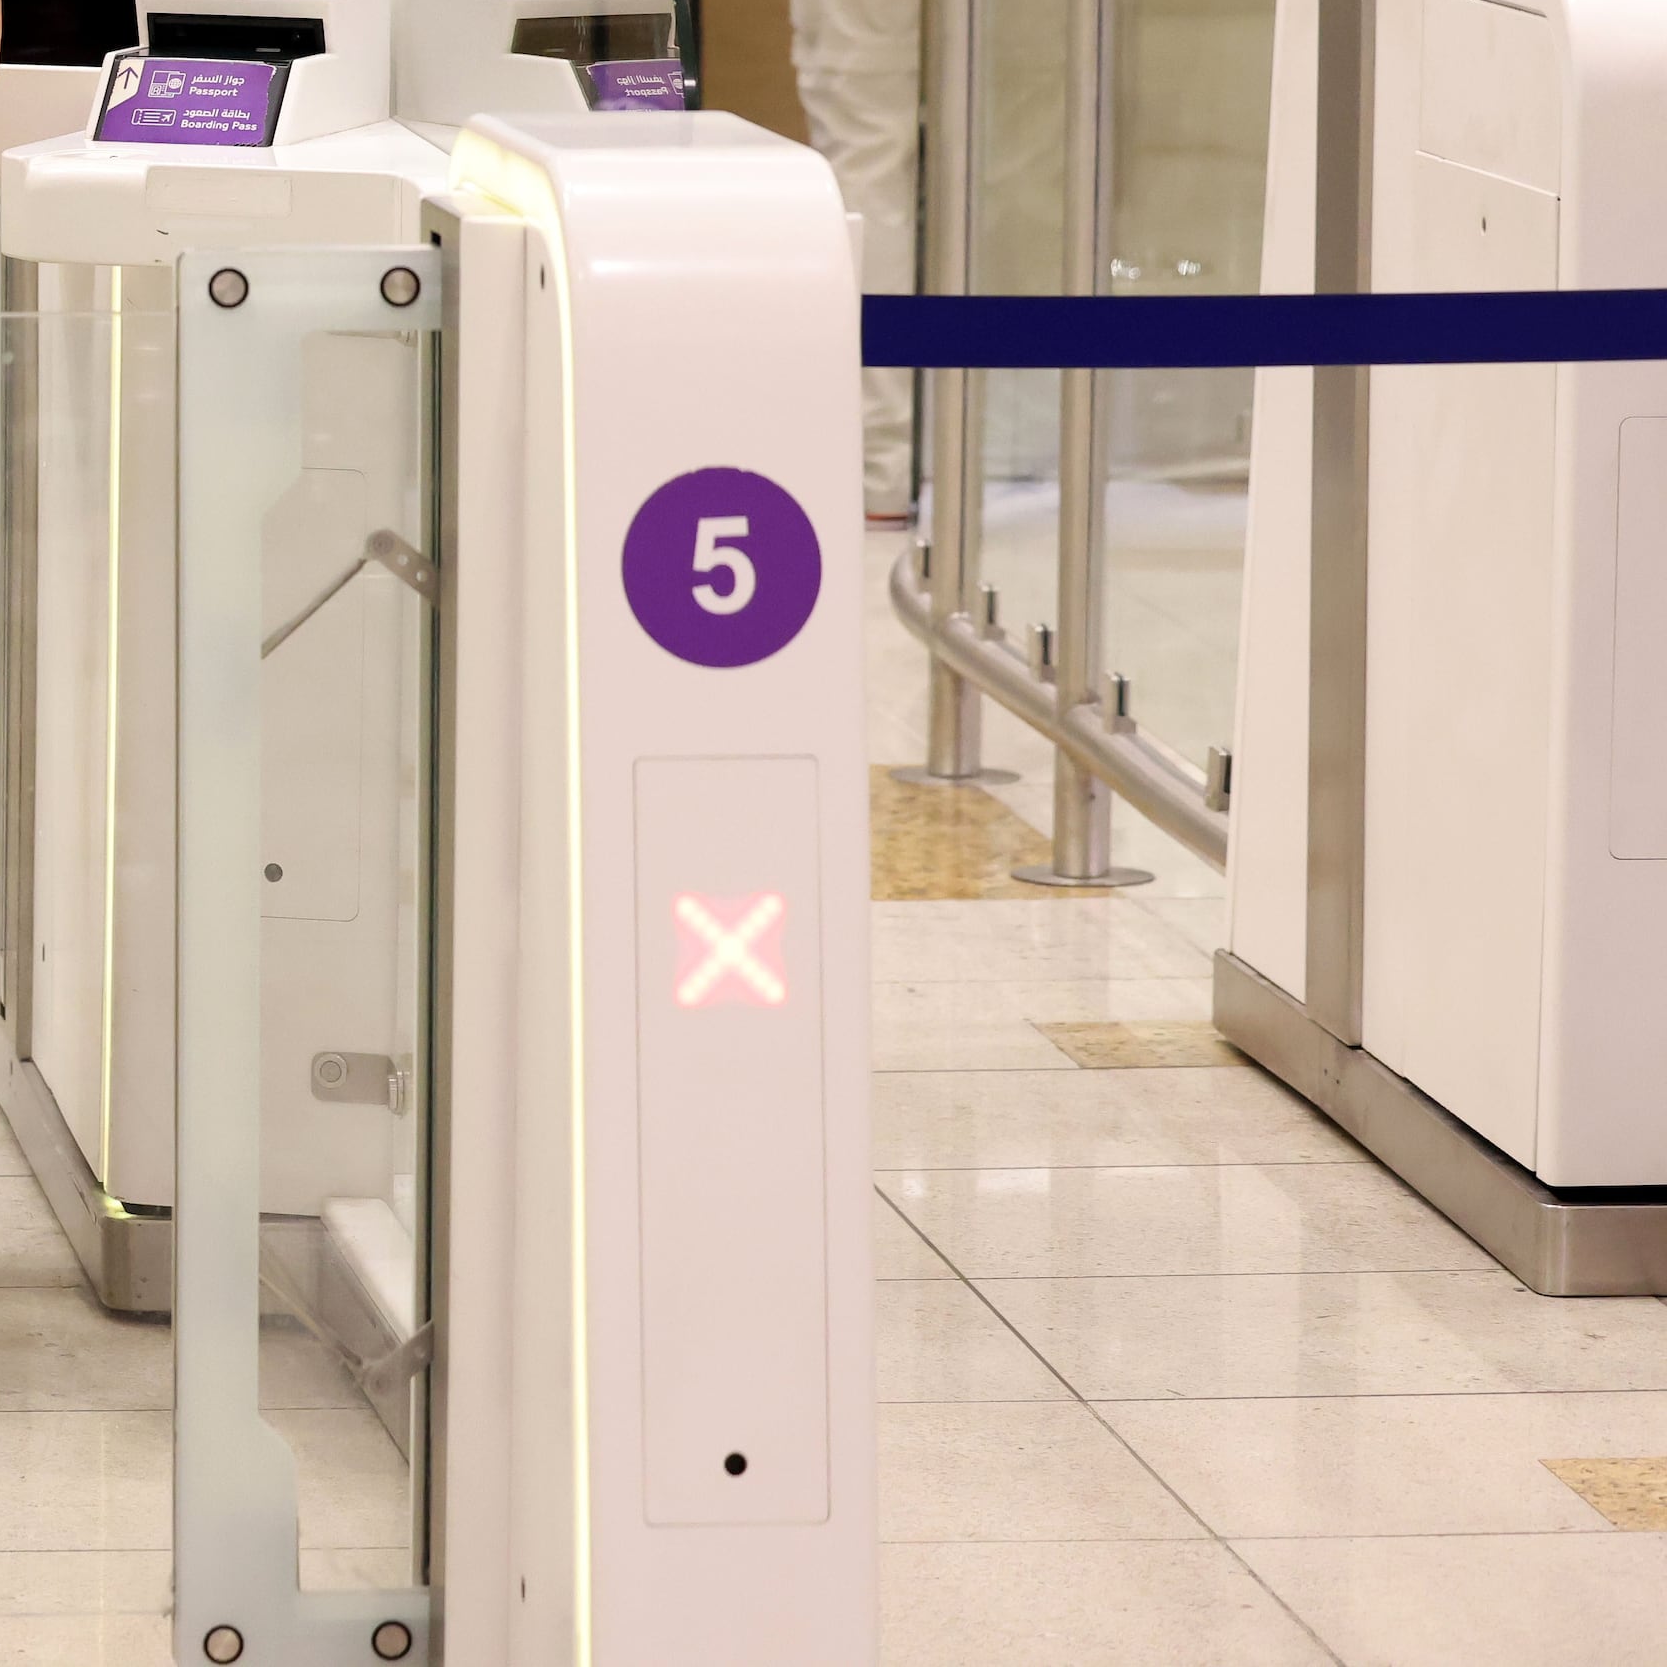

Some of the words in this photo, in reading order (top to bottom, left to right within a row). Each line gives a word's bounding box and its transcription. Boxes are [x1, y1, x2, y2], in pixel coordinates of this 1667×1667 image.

[191, 74, 222, 84] السفر
[224, 76, 245, 86] جواز
[188, 87, 238, 97] Passport
[182, 109, 218, 118] الصعود
[221, 109, 251, 120] بطاقة
[180, 119, 229, 131] Boarding
[231, 121, 258, 131] Pass
[691, 515, 757, 616] 5
